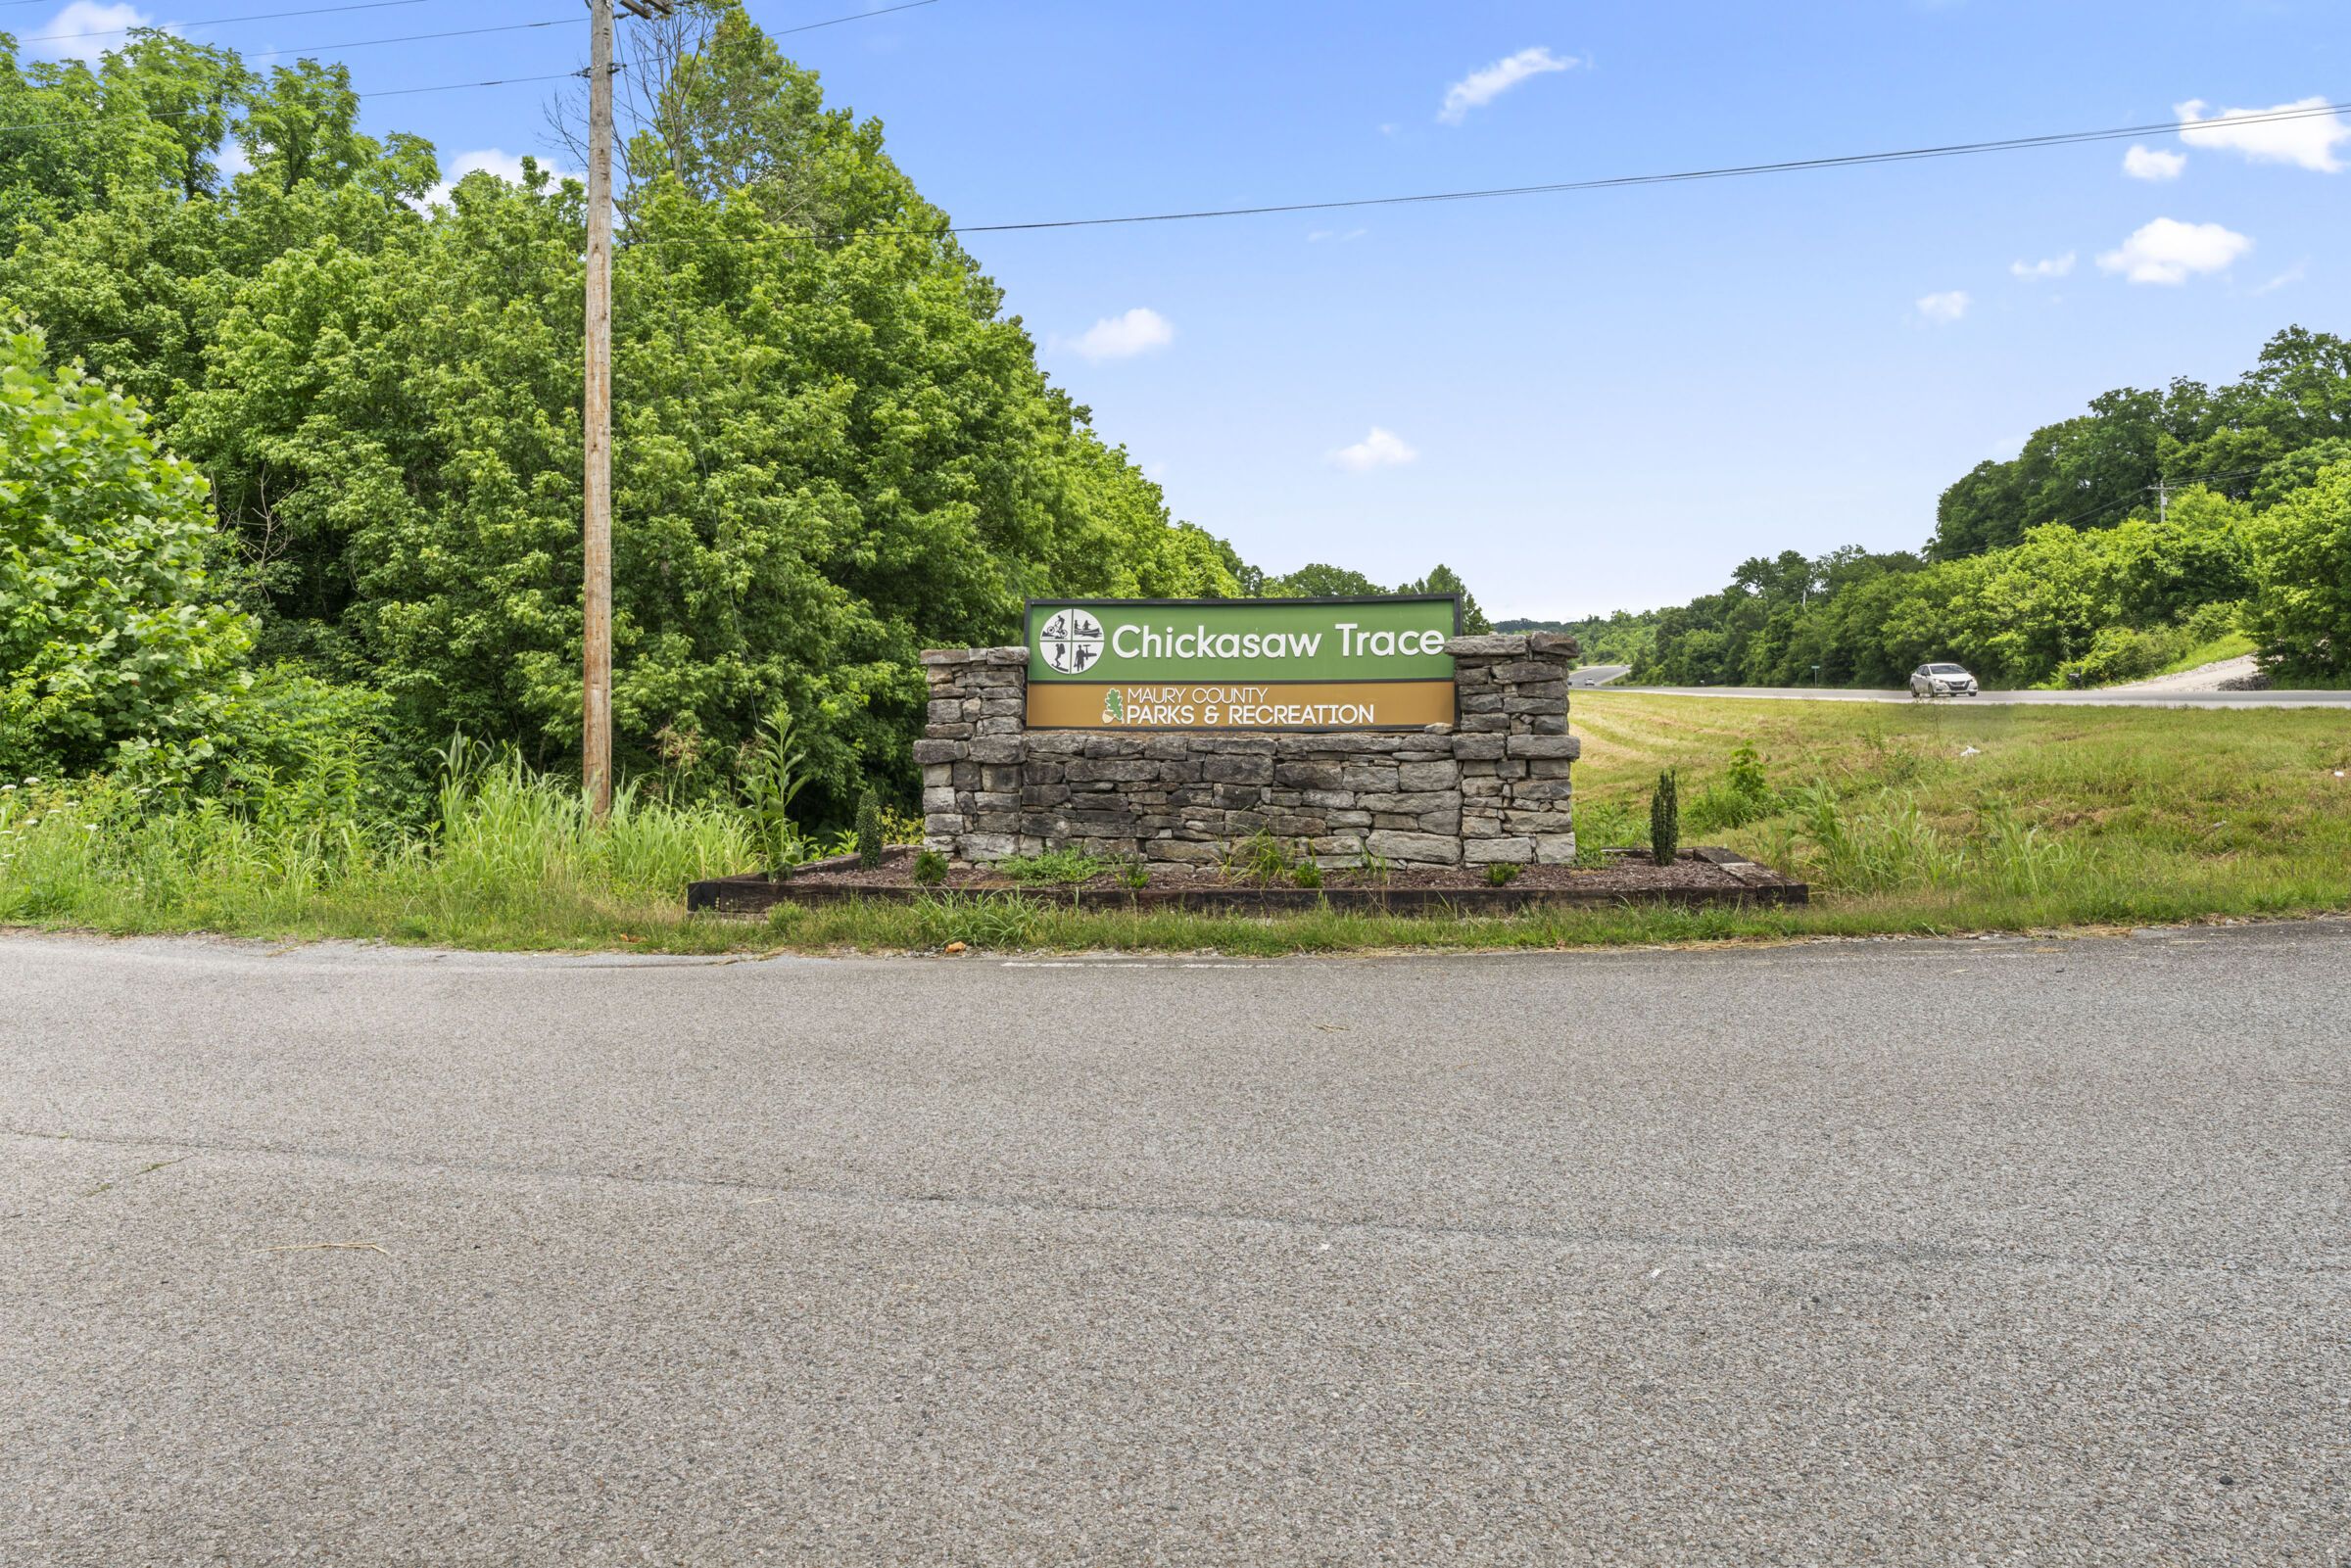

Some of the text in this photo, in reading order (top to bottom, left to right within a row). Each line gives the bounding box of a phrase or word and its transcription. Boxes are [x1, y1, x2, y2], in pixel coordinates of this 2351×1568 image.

[1112, 623, 1445, 658] Chickasaw Trace
[1127, 687, 1269, 704] MAURY COUNTY
[1127, 704, 1374, 725] PARKS & RECREATION
